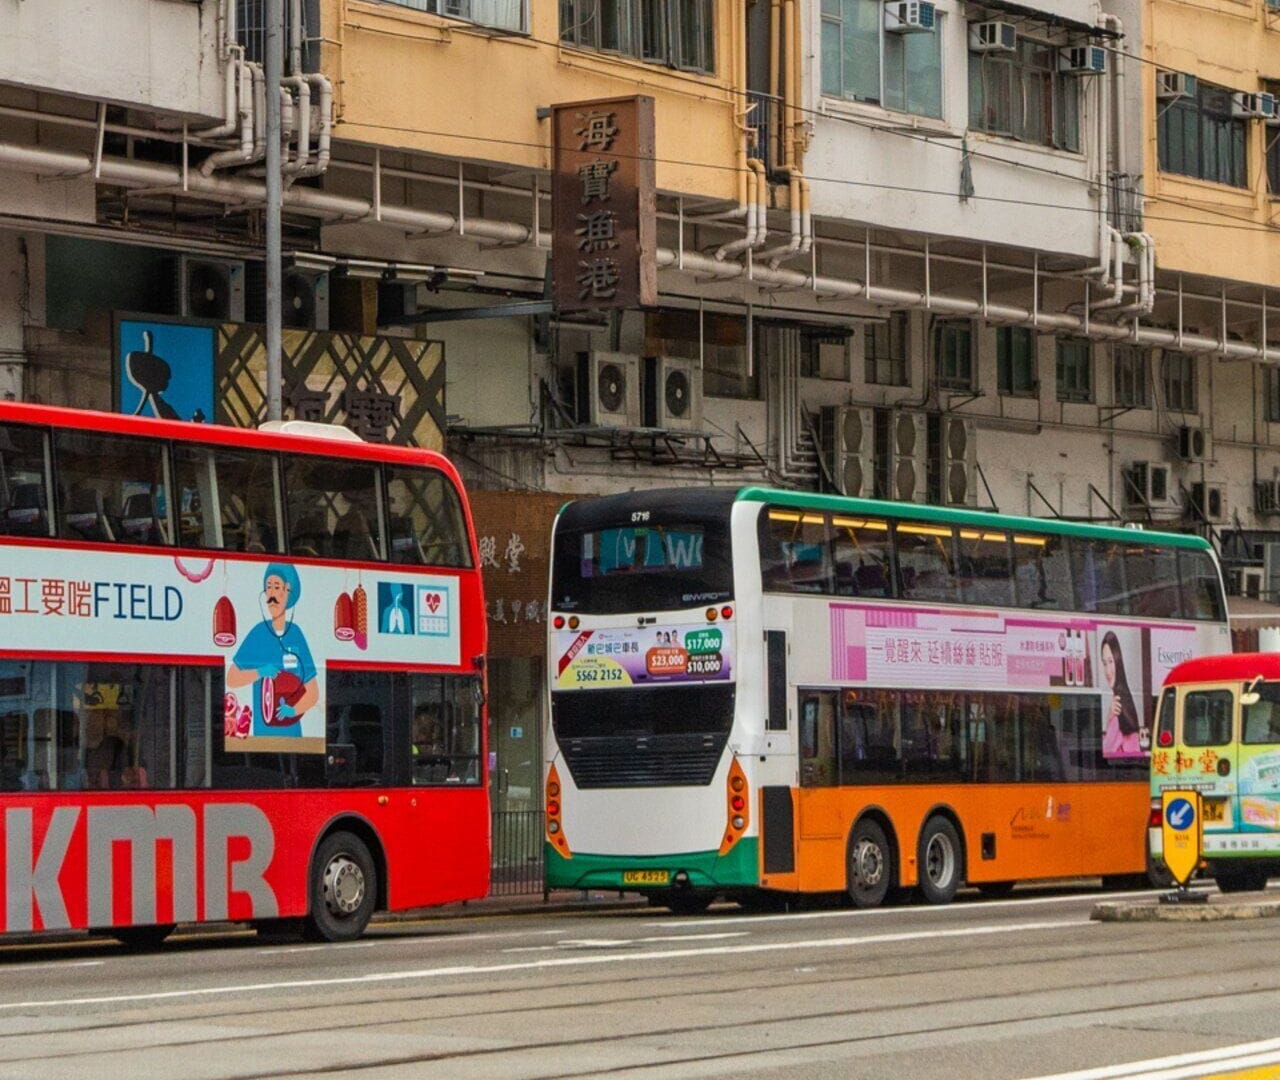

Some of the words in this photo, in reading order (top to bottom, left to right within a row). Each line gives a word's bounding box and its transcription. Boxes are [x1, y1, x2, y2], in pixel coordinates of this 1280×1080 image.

[575, 110, 618, 300] 海寶漁港
[687, 637, 721, 650] $17,000
[651, 653, 685, 668] $23,000
[687, 659, 721, 674] $10,000
[576, 668, 599, 682] 5562
[601, 666, 622, 681] 2152
[6, 803, 279, 932] KMB
